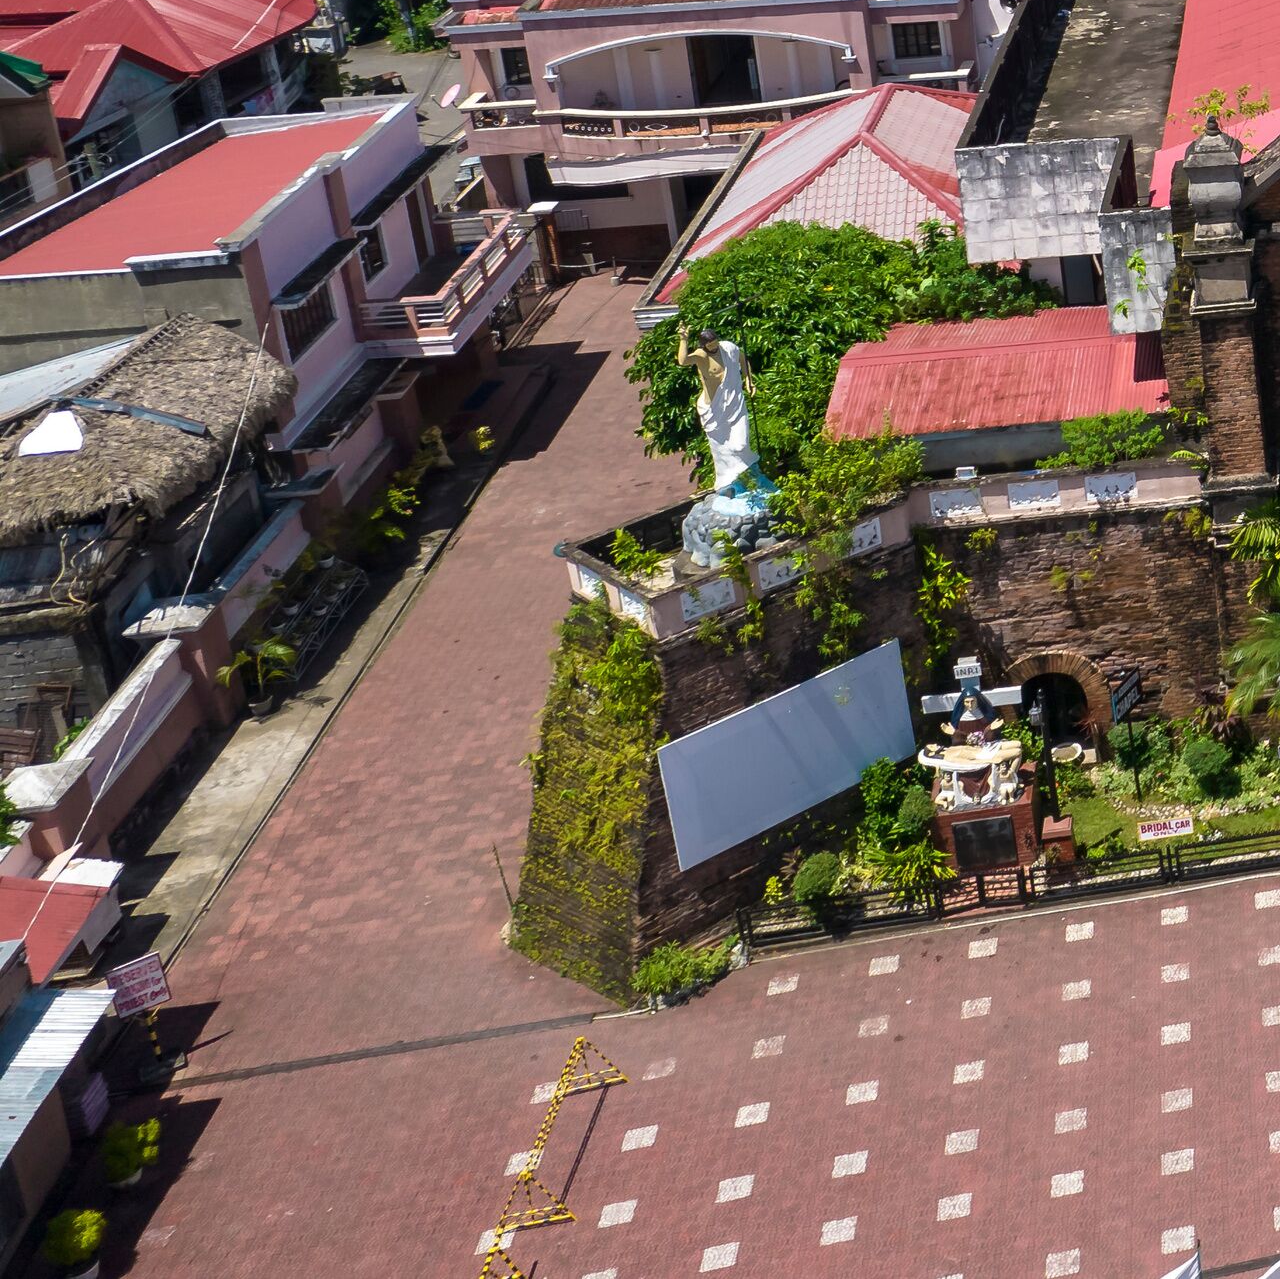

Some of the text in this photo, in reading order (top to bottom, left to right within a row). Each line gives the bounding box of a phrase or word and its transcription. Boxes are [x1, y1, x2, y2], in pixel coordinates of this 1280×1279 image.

[1140, 819, 1191, 834] BRIDAL CAR
[1152, 828, 1179, 837] ONLY
